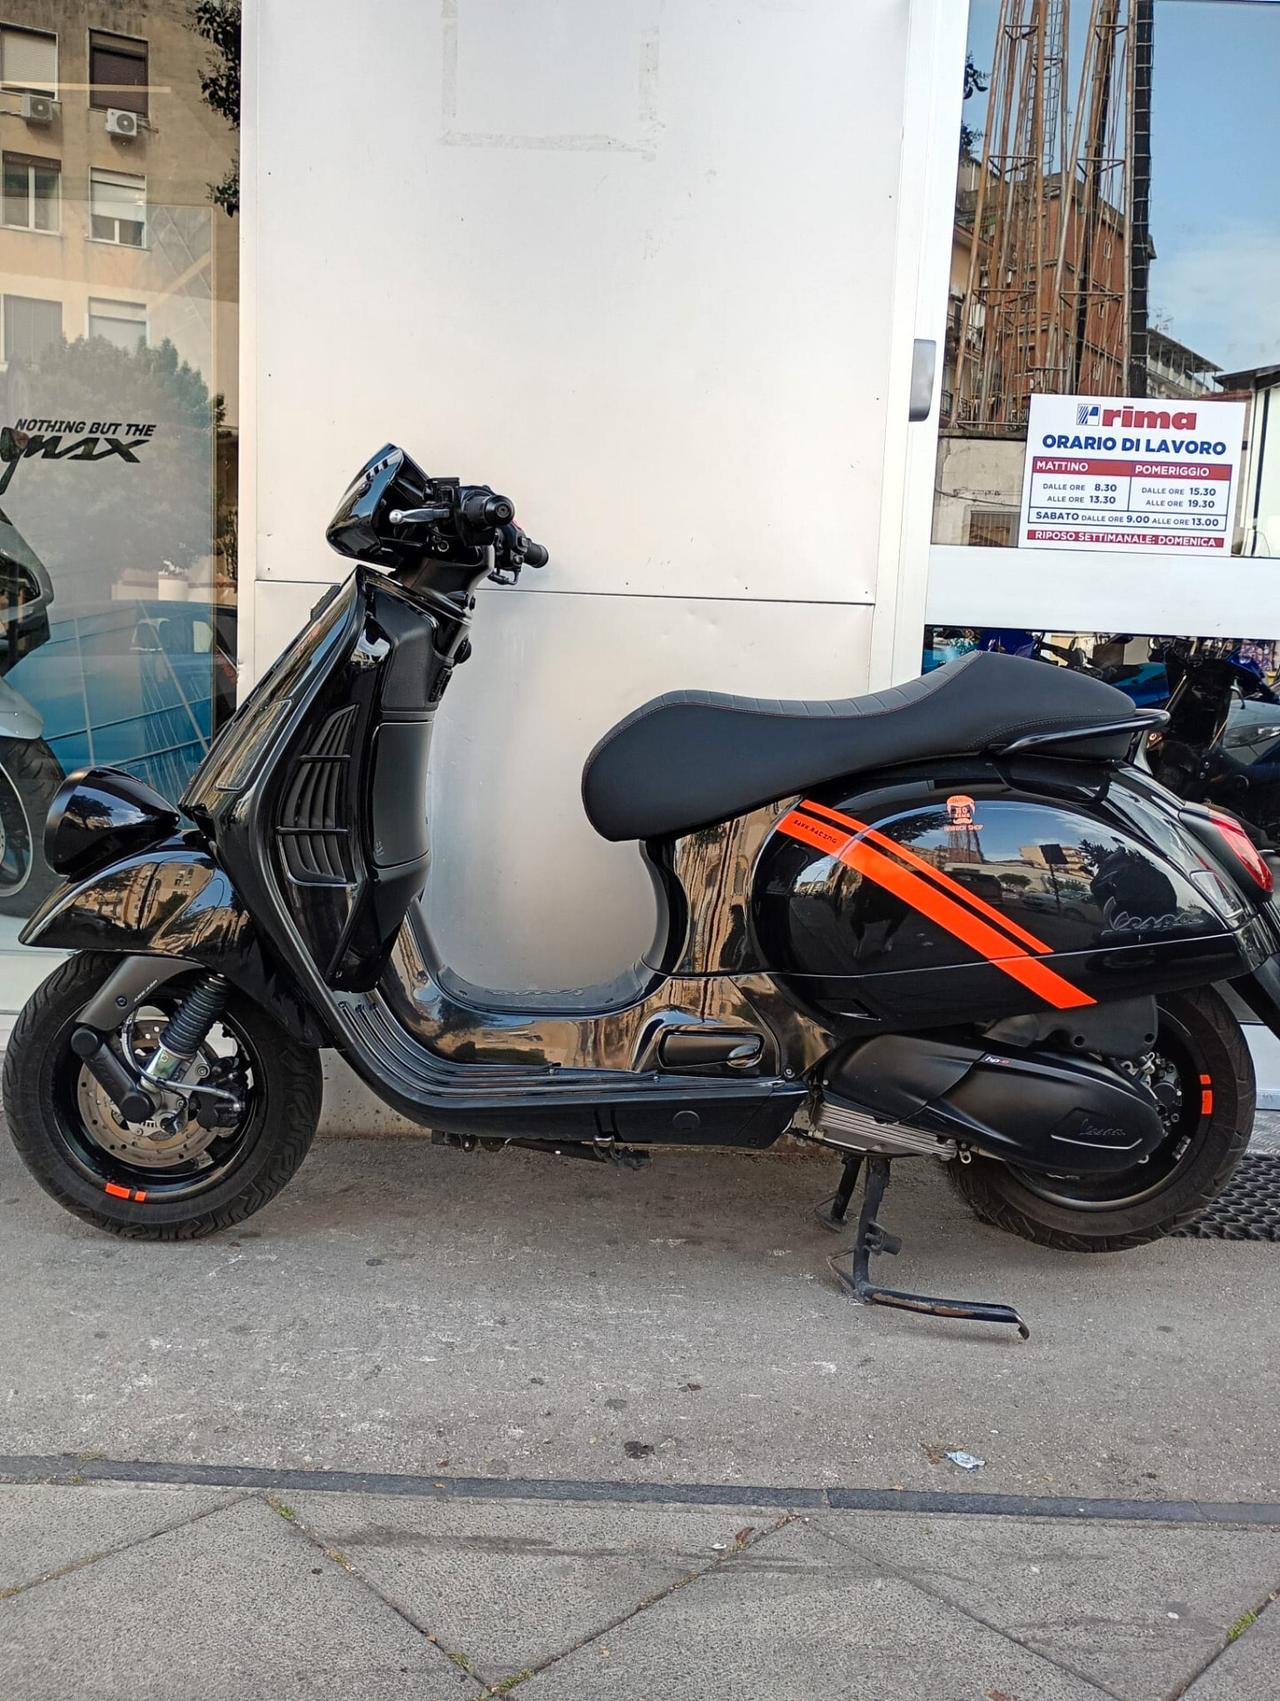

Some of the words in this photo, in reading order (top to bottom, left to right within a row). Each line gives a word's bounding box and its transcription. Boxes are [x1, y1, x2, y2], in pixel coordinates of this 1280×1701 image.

[1102, 405, 1197, 430] rima
[15, 419, 86, 433] NOTHING
[88, 422, 122, 435] BUT
[125, 424, 156, 437] THE
[1042, 434, 1117, 451] ORARIO
[1121, 438, 1140, 452] DI
[1145, 439, 1227, 456] LAVORO
[1036, 461, 1089, 472] MATTINO
[1135, 465, 1210, 477] POMERIGGIO
[1043, 483, 1067, 491] DALLE
[1094, 483, 1117, 492] 8.30
[1141, 487, 1166, 495] DALLE
[1168, 488, 1185, 496] ORE
[1189, 487, 1217, 497] 15.30
[1047, 495, 1067, 503] ALLE
[1089, 495, 1116, 504] 13.30
[1145, 499, 1165, 507] ALLE
[1167, 500, 1183, 508] ORE
[1188, 499, 1215, 509] 19.30
[1035, 511, 1079, 521] SABATO
[1081, 514, 1106, 522] DALLE
[1108, 515, 1124, 523] ORE
[1126, 515, 1150, 524] 9.00
[1151, 517, 1171, 525] ALLE
[1173, 518, 1190, 526] ORE
[1191, 517, 1219, 527] 13.00
[1035, 530, 1075, 540] RIPOSO
[1078, 532, 1155, 545] SETTIMANALE:
[1158, 536, 1216, 547] DOMENICA
